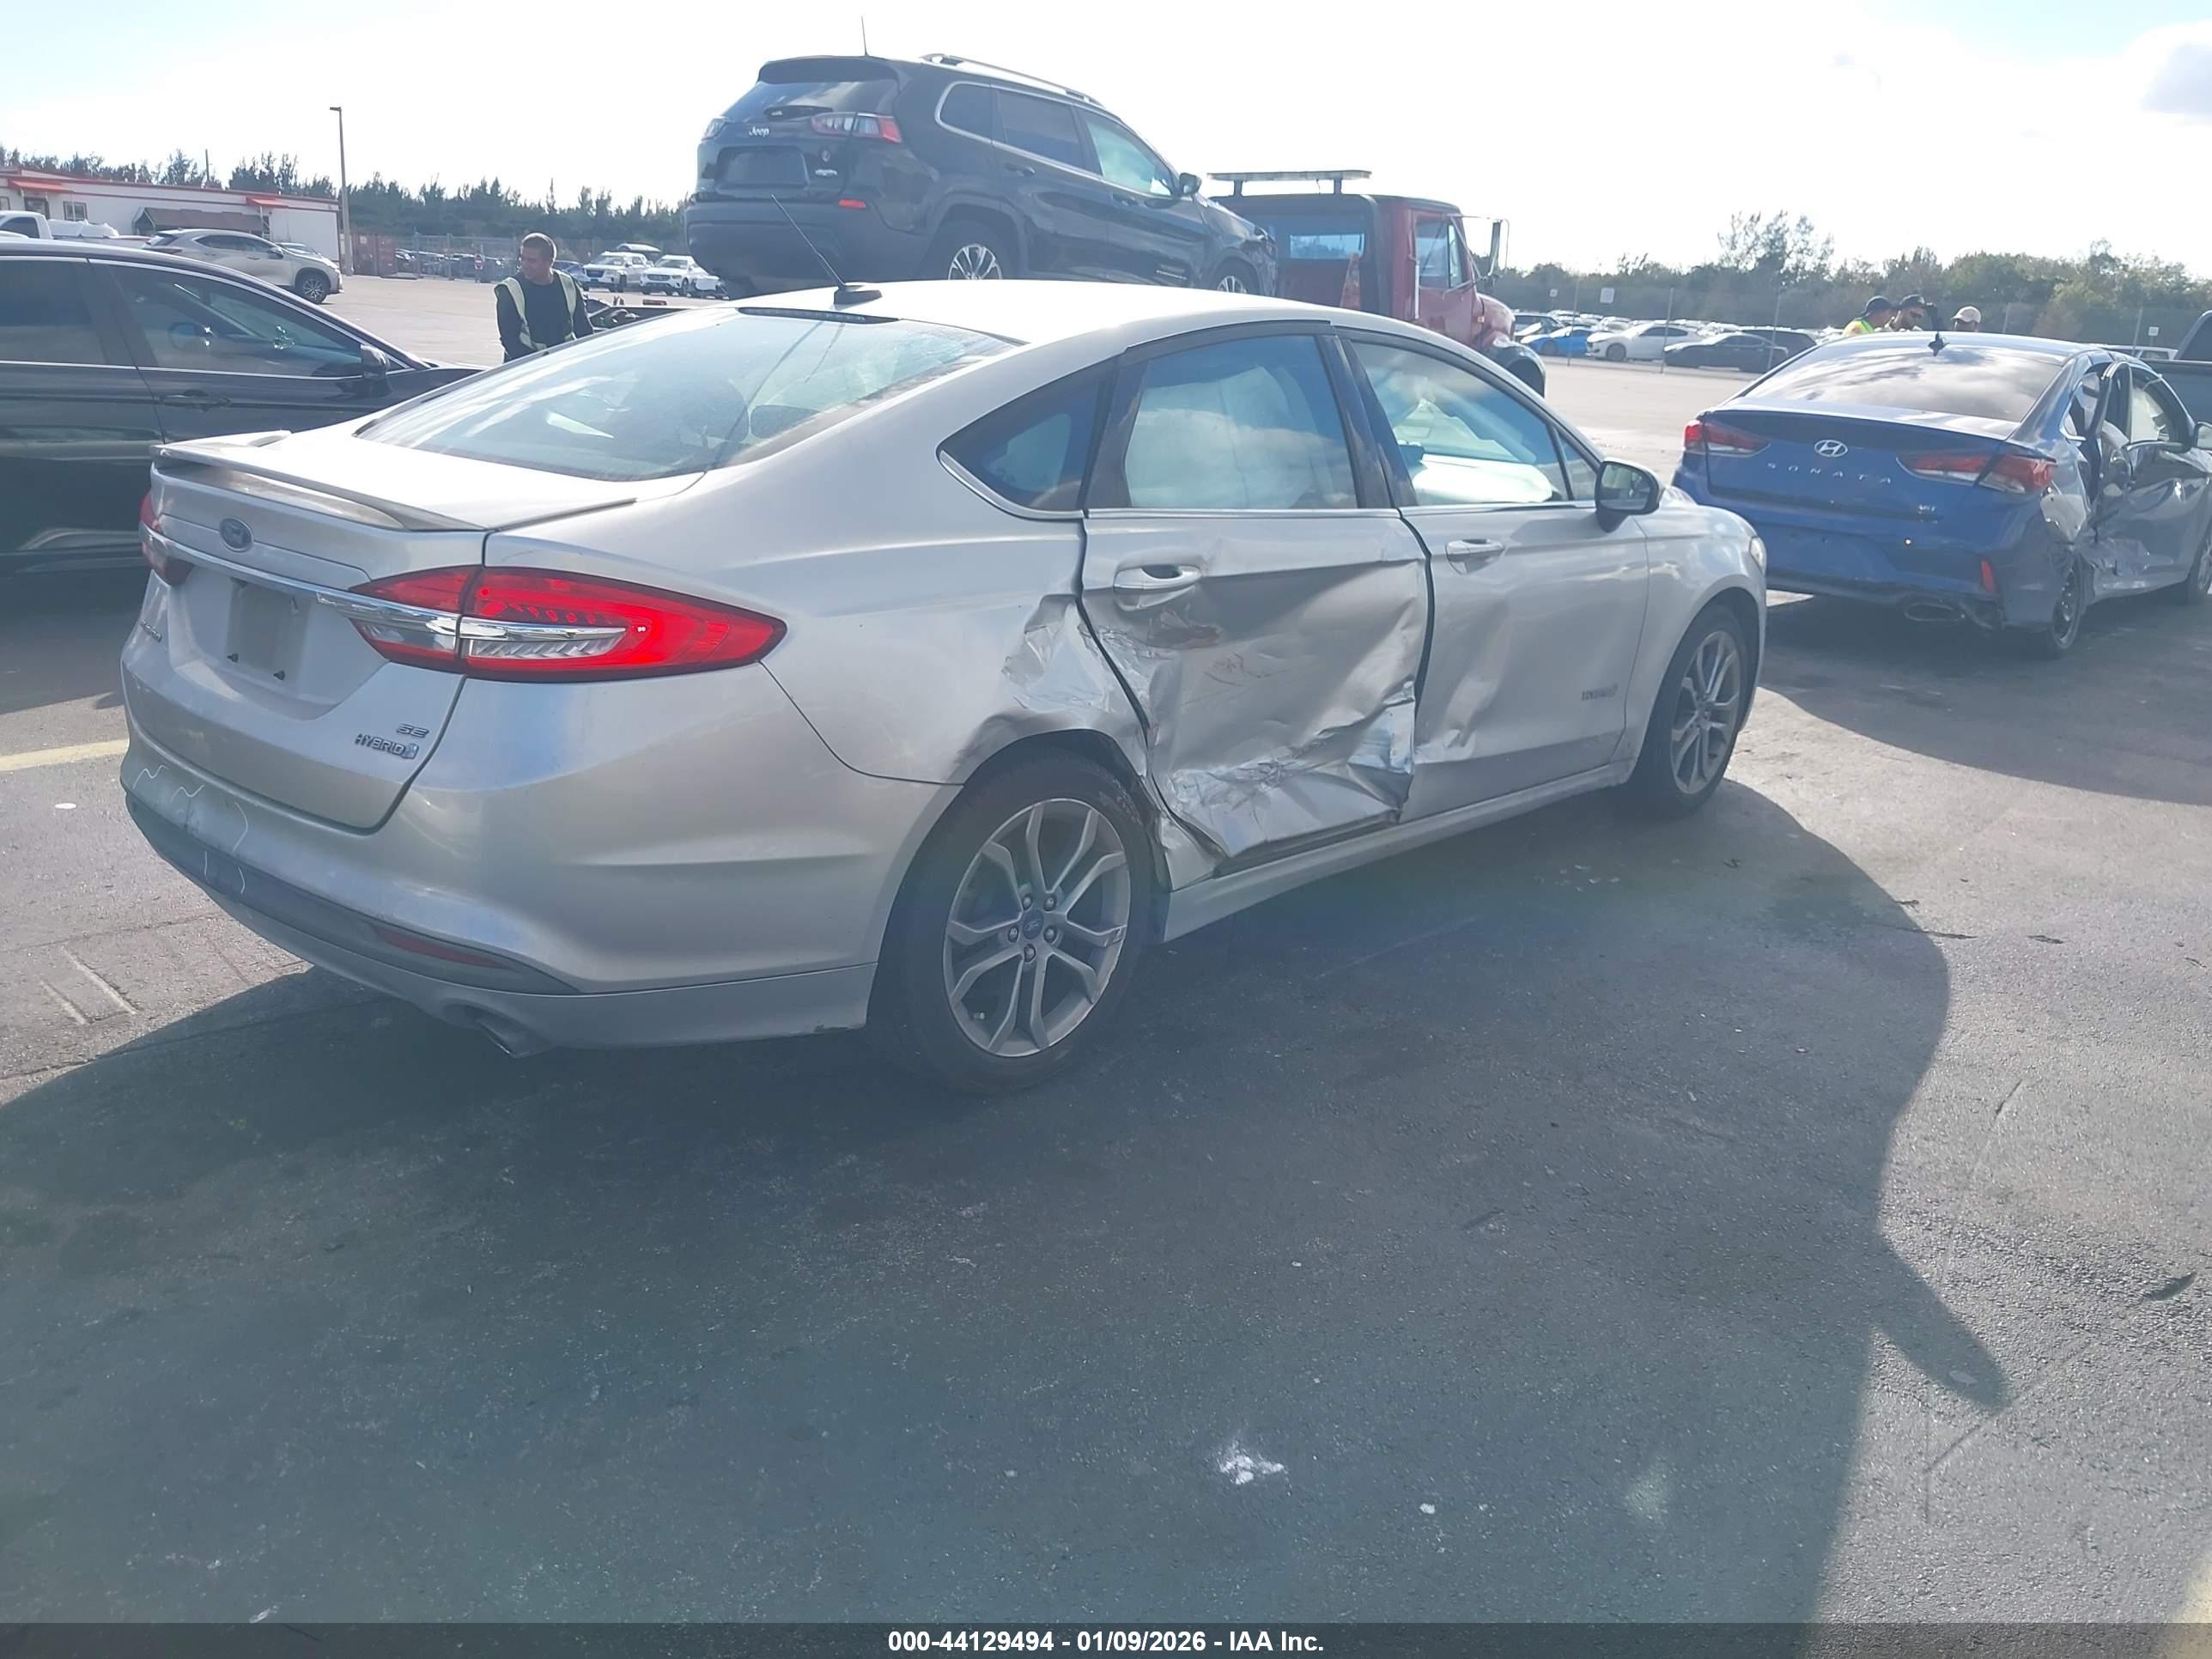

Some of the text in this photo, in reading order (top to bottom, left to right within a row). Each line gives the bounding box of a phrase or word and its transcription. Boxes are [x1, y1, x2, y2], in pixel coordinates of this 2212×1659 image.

[748, 125, 770, 138] Jeep
[1766, 461, 1892, 486] SONATA
[397, 723, 429, 738] SE
[355, 733, 407, 757] HYBRID
